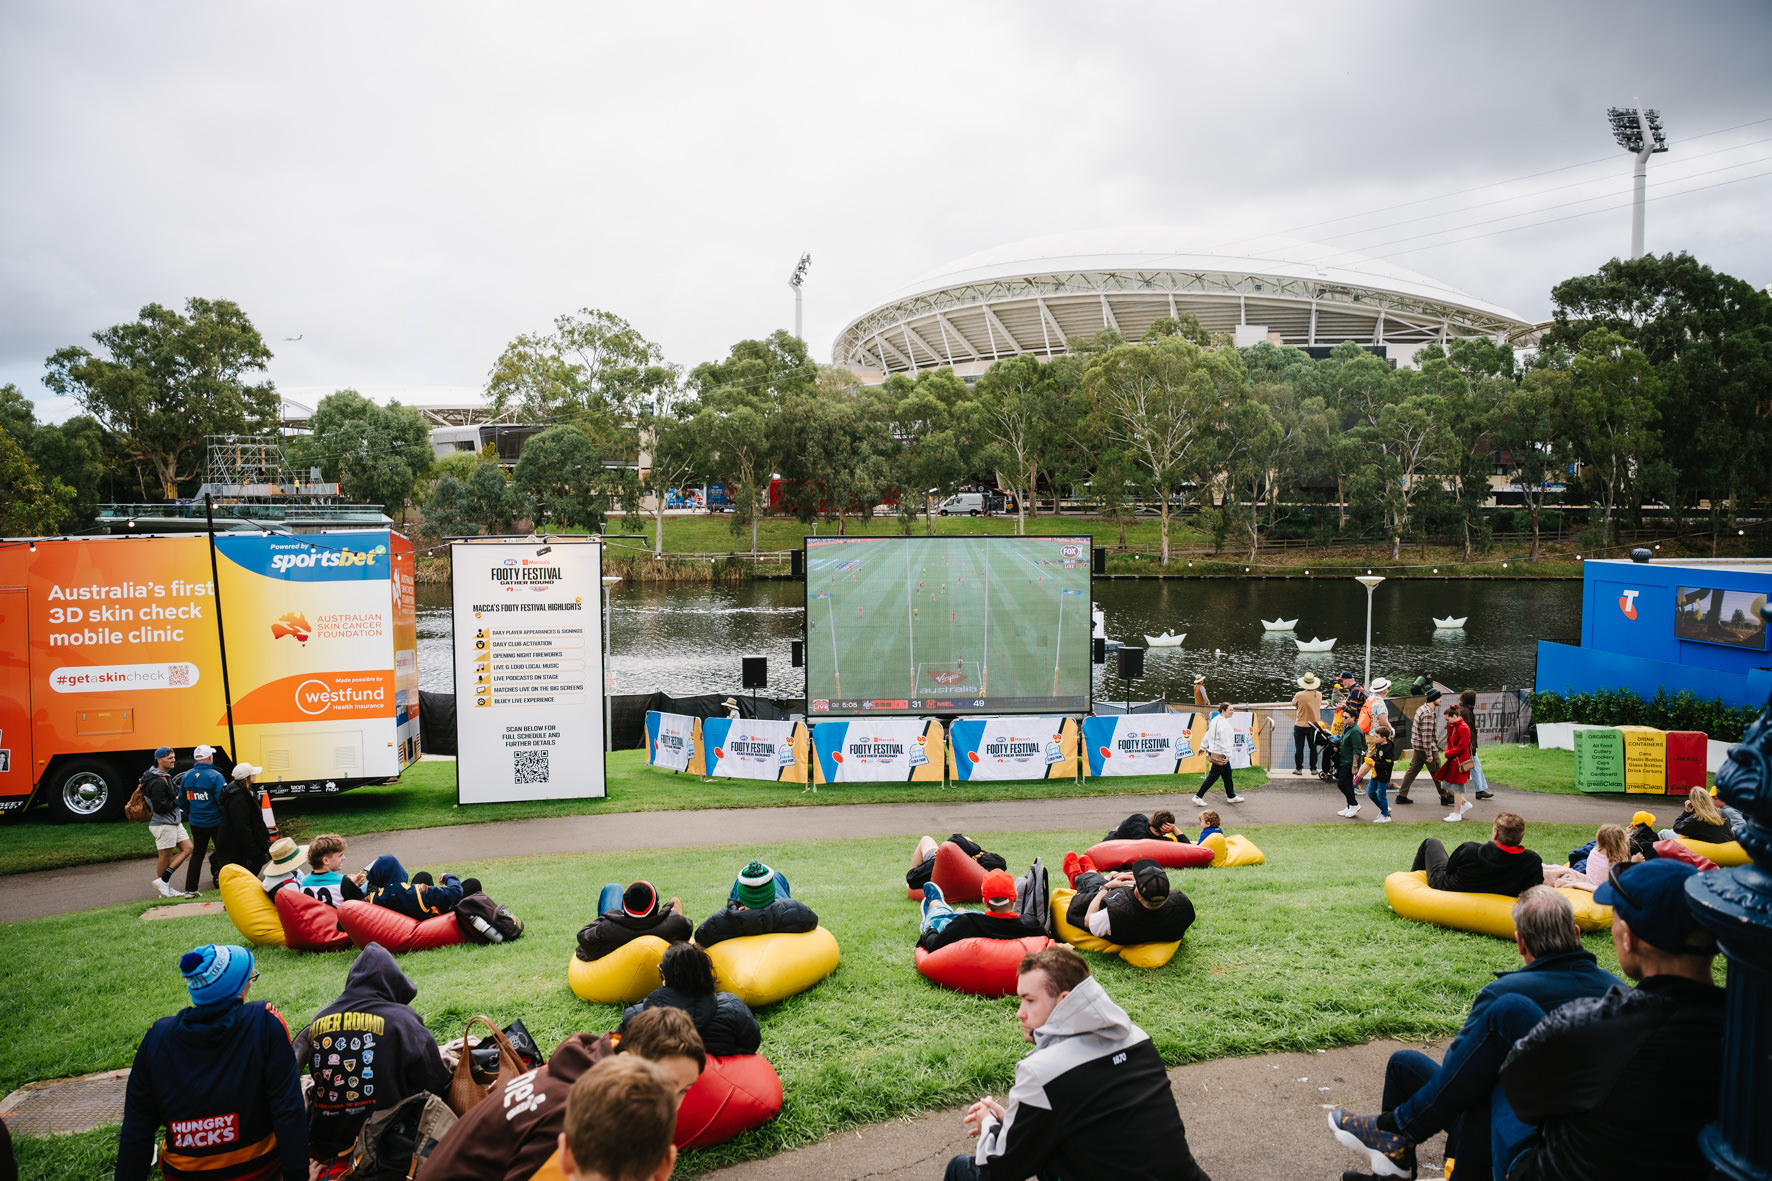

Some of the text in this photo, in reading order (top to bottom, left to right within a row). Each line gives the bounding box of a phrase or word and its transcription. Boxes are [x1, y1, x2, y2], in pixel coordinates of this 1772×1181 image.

[271, 548, 376, 573] sportsbet
[491, 567, 562, 580] FOOTY FESTIVAL
[48, 580, 215, 601] Australia's first
[49, 602, 203, 623] 3D skin check
[473, 603, 500, 612] MACCA'S
[548, 602, 581, 611] HIGHLIGHTS
[317, 614, 382, 622] AUSTRALIAN
[50, 626, 184, 646] mobile clinic
[318, 630, 382, 638] FOUNDATION
[56, 670, 165, 686] #getaskincheck
[305, 686, 384, 703] westfund
[920, 686, 977, 694] australia
[731, 741, 775, 754] FOOTY FESTIVAL
[850, 744, 904, 754] FOOTY FESTIVAL
[986, 743, 1040, 754] FOOTY FESTIVAL
[1118, 738, 1170, 750] FOOTY FESTIVAL
[343, 1012, 385, 1036] ROUND
[172, 1115, 234, 1133] HUNGRY
[176, 1127, 234, 1147] JACK'S
